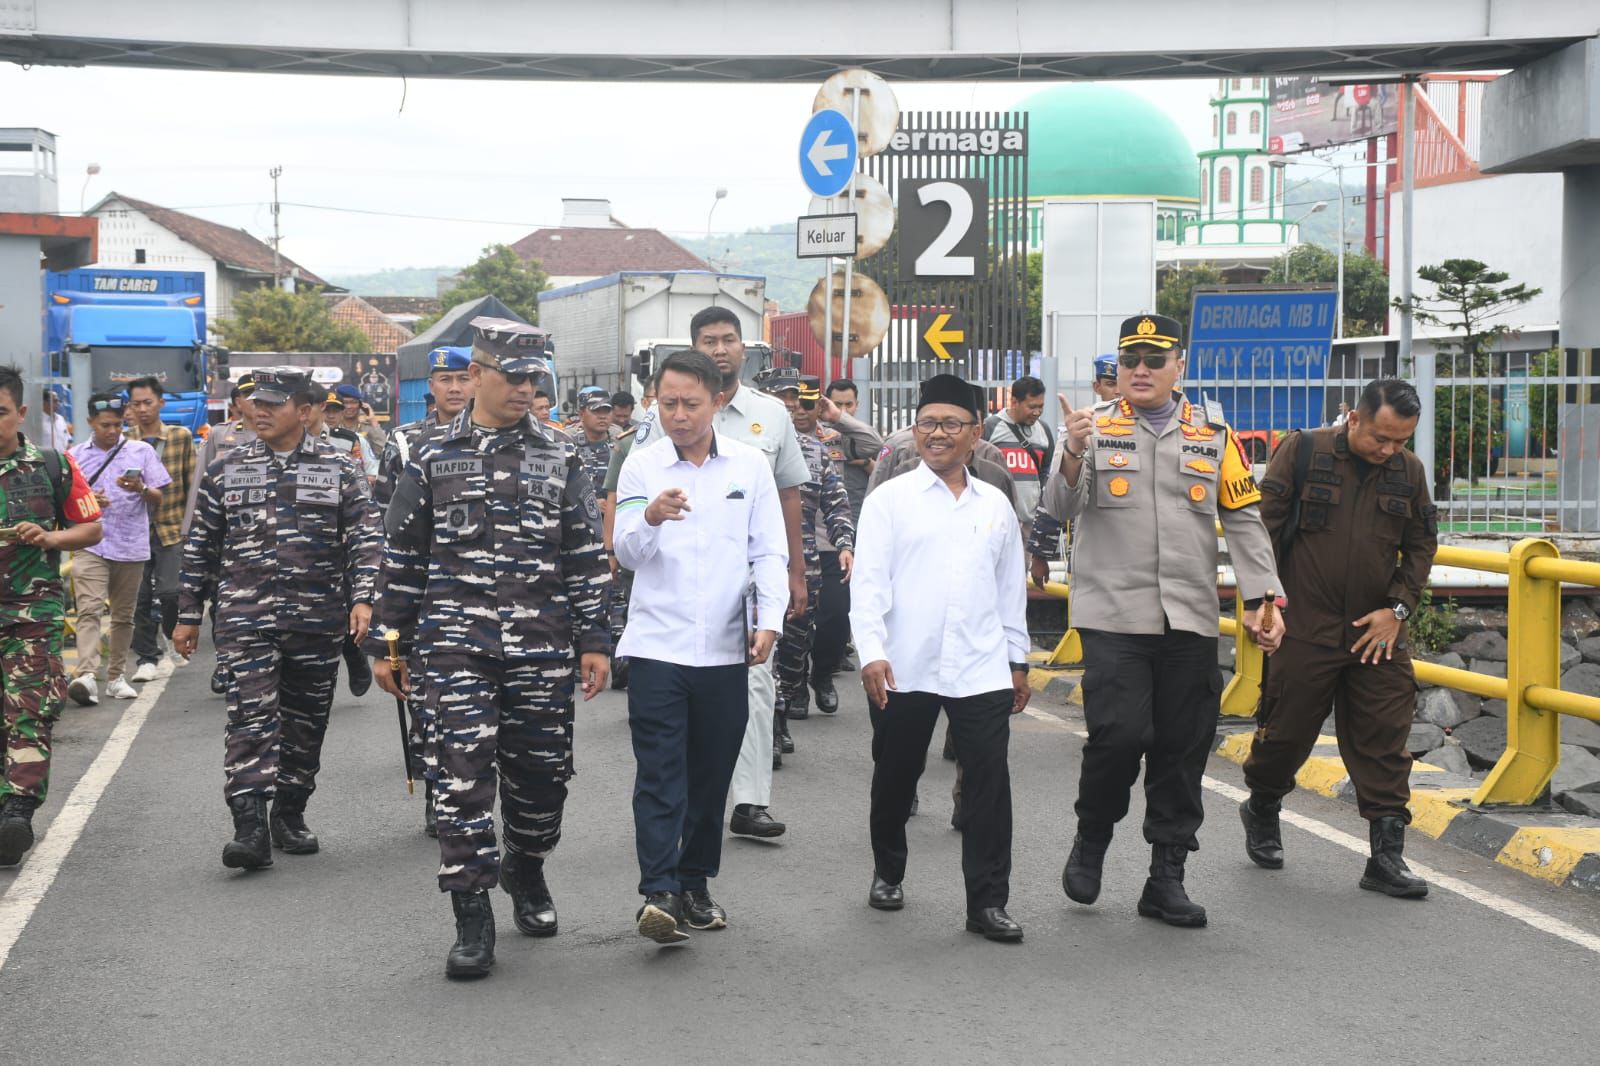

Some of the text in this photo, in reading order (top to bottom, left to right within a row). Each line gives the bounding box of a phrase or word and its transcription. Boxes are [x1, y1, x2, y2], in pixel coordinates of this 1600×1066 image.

[891, 130, 1023, 155] ermaga
[914, 181, 976, 276] 2
[807, 229, 846, 244] Keluar
[94, 277, 158, 293] TAM CARGO
[1200, 303, 1328, 329] DERMAGA MB II
[1197, 345, 1323, 369] MAX 20 TON
[1097, 439, 1137, 451] NANANG
[1182, 444, 1218, 459] POLRI
[435, 461, 476, 474] HAFIDZ
[528, 462, 563, 477] TNI AL
[302, 475, 335, 486] TNI AL
